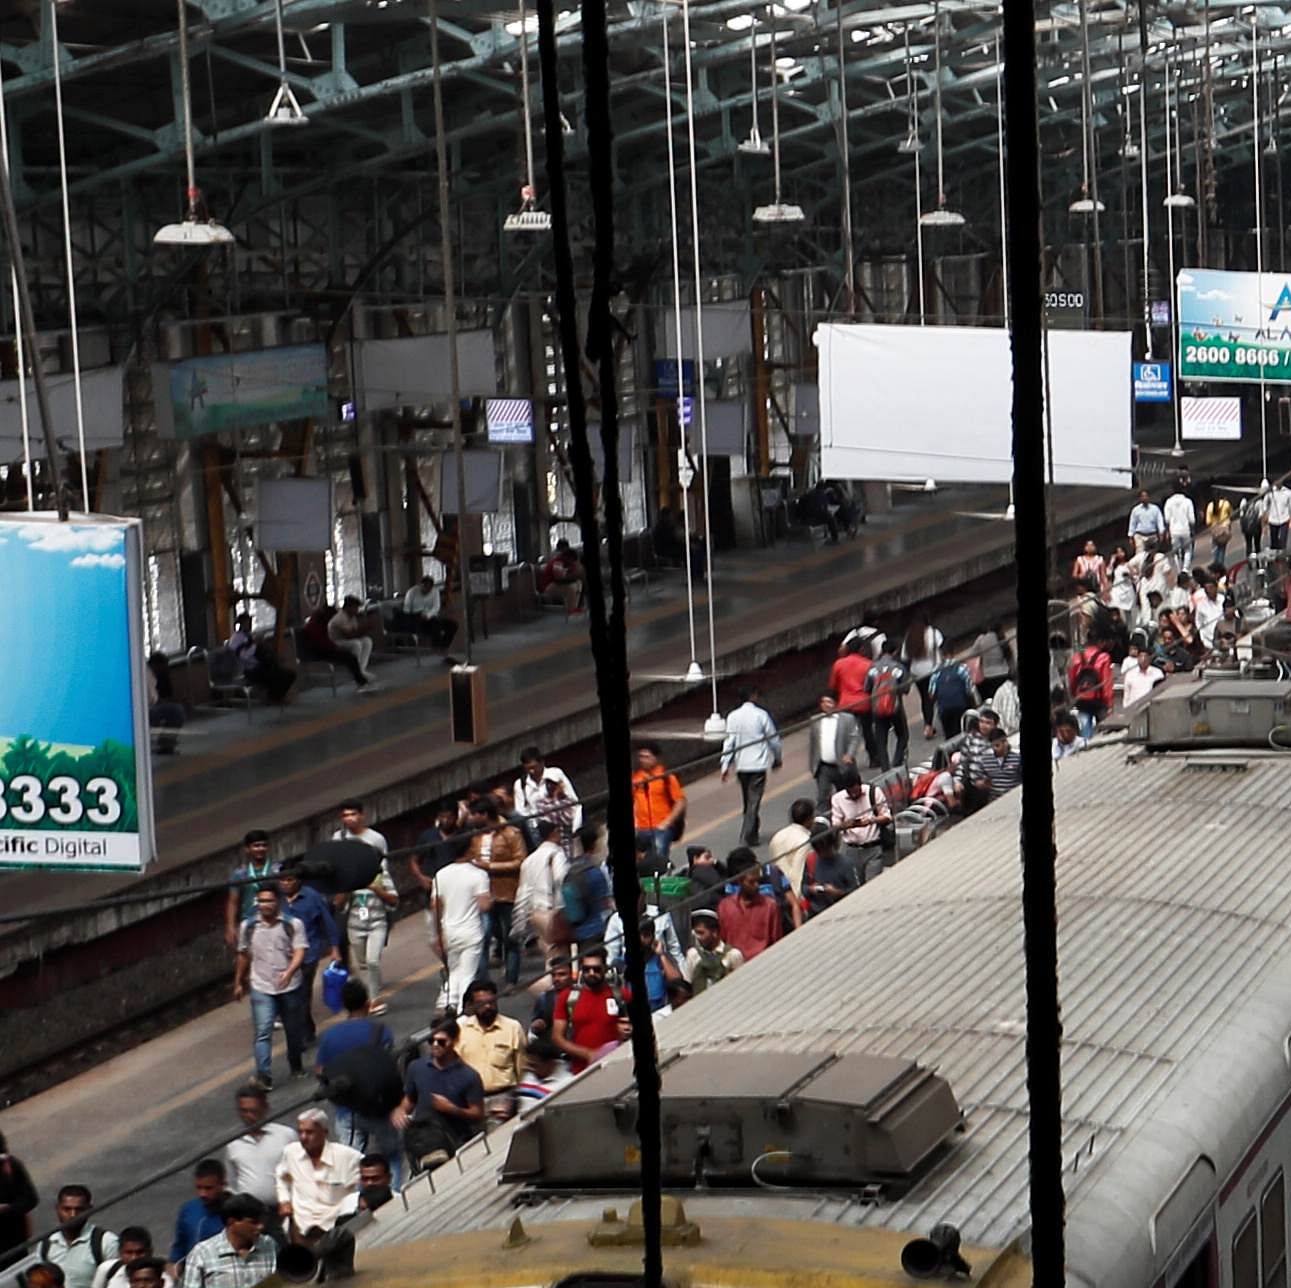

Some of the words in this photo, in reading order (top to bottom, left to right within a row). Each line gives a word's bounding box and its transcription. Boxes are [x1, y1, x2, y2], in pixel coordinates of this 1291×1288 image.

[1185, 345, 1230, 365] 2600
[1235, 347, 1279, 367] 8666
[0, 775, 121, 825] 333
[45, 837, 107, 859] Digital
